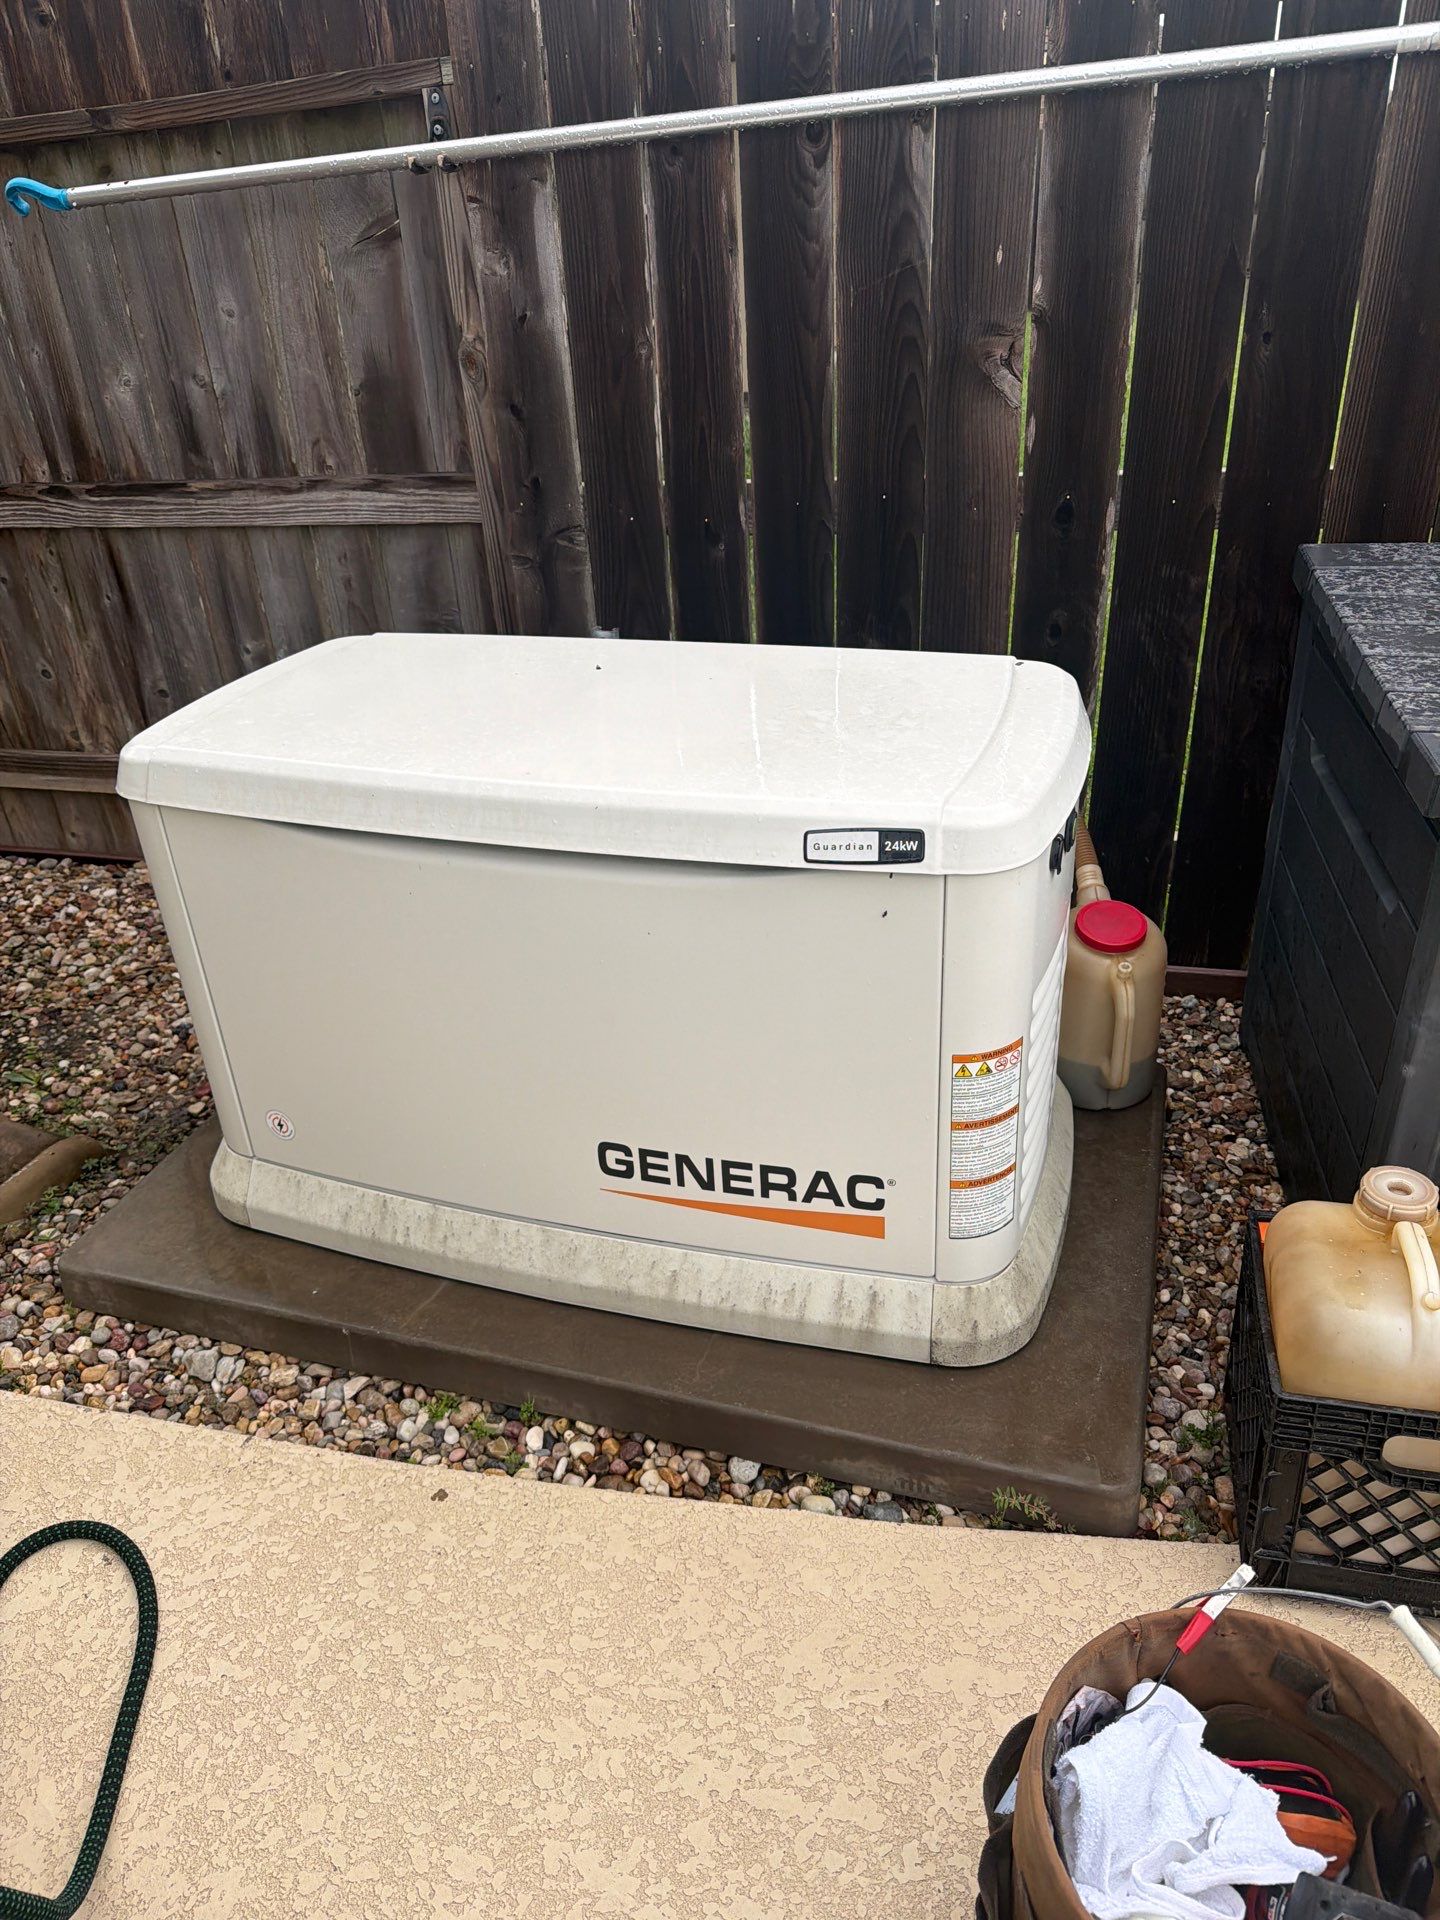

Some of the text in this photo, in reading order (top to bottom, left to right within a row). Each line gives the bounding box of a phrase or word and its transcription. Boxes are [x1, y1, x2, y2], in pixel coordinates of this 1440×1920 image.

[813, 841, 919, 852] Guardian 24kW
[981, 1044, 1013, 1060] WARNING
[964, 1107, 1019, 1129] AVERTISSEMENT
[597, 1141, 886, 1212] GENERAC
[968, 1167, 1014, 1187] ADVERTENCIA
